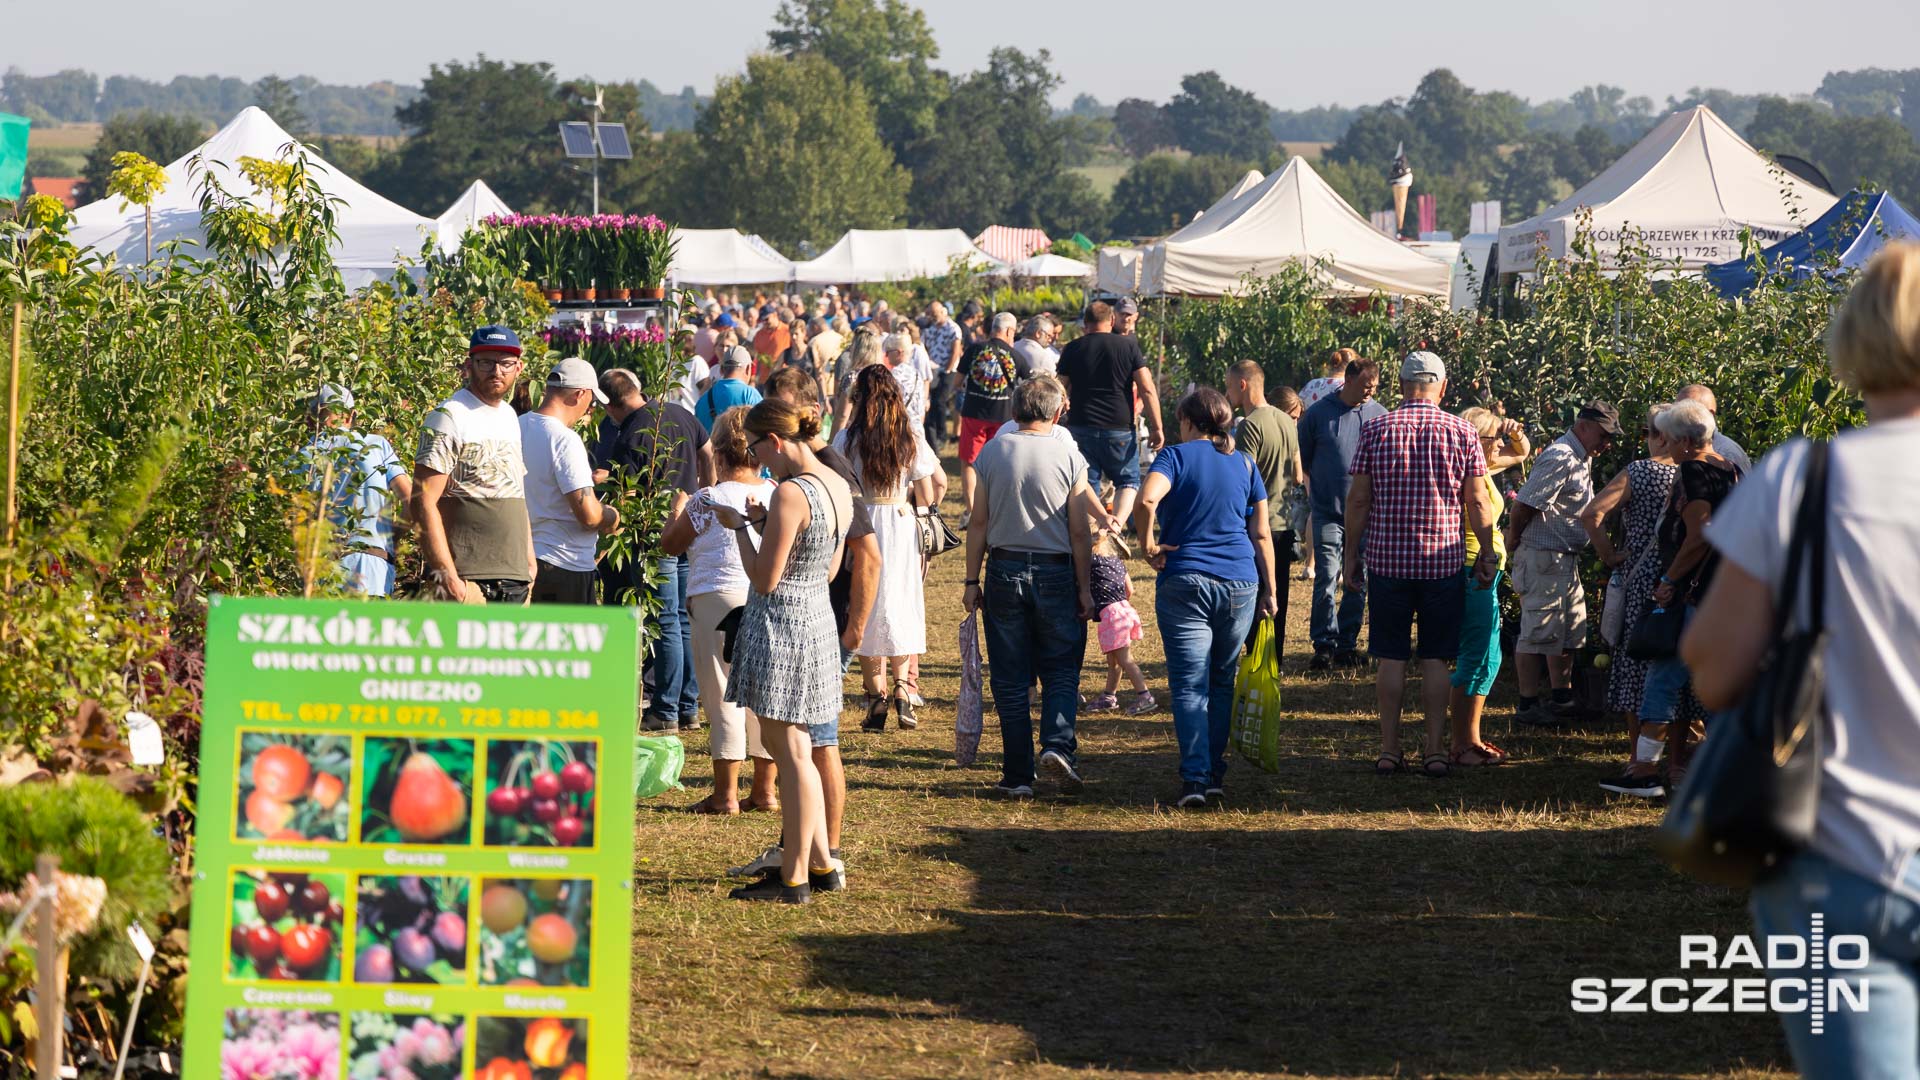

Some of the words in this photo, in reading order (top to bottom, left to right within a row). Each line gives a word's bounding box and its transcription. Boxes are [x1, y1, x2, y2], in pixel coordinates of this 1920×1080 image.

[1579, 226, 1634, 241] KÓŁKA
[1640, 230, 1699, 241] DRZEWEK
[1668, 247, 1689, 257] 111
[1694, 246, 1718, 257] 725
[237, 609, 443, 648] SZKÓŁKA
[457, 619, 608, 652] DRZEW
[252, 651, 415, 674] OWOCOWYCH
[421, 655, 433, 675] I
[437, 656, 592, 679] OZDOBNYCH
[360, 678, 482, 703] GNIEZNO
[240, 700, 293, 721] TEL.
[298, 703, 342, 722] 697
[348, 704, 389, 724] 721
[383, 848, 446, 866] Grusze
